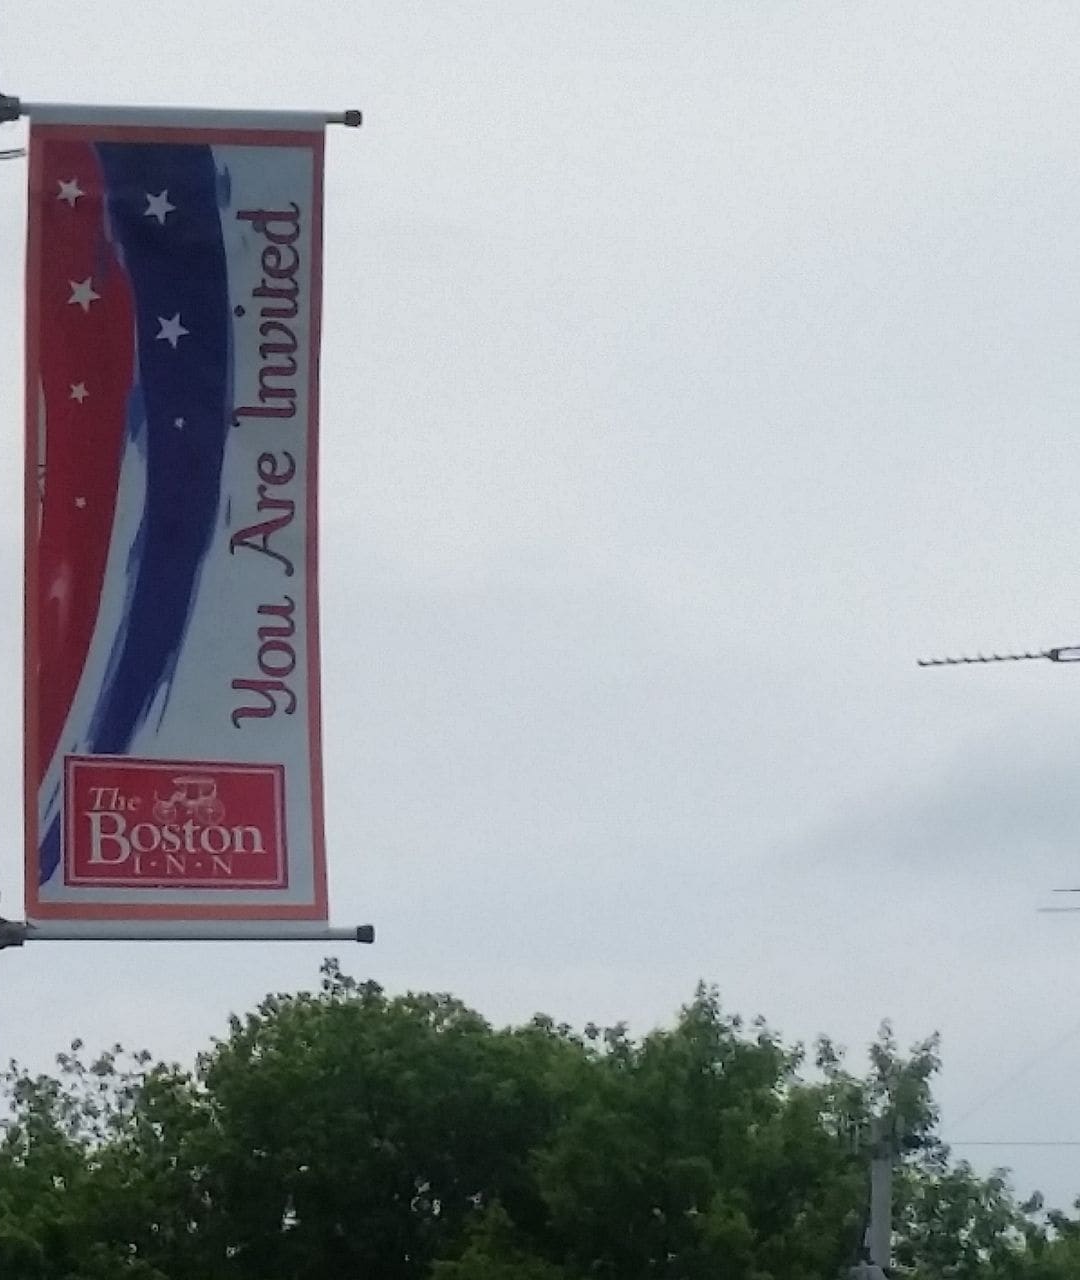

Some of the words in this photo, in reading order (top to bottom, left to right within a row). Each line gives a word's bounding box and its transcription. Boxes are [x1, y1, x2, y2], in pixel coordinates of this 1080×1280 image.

[231, 201, 301, 428] Invited
[229, 450, 296, 577] Are
[231, 594, 297, 729] You
[85, 811, 267, 865] Boston
[89, 787, 142, 811] The
